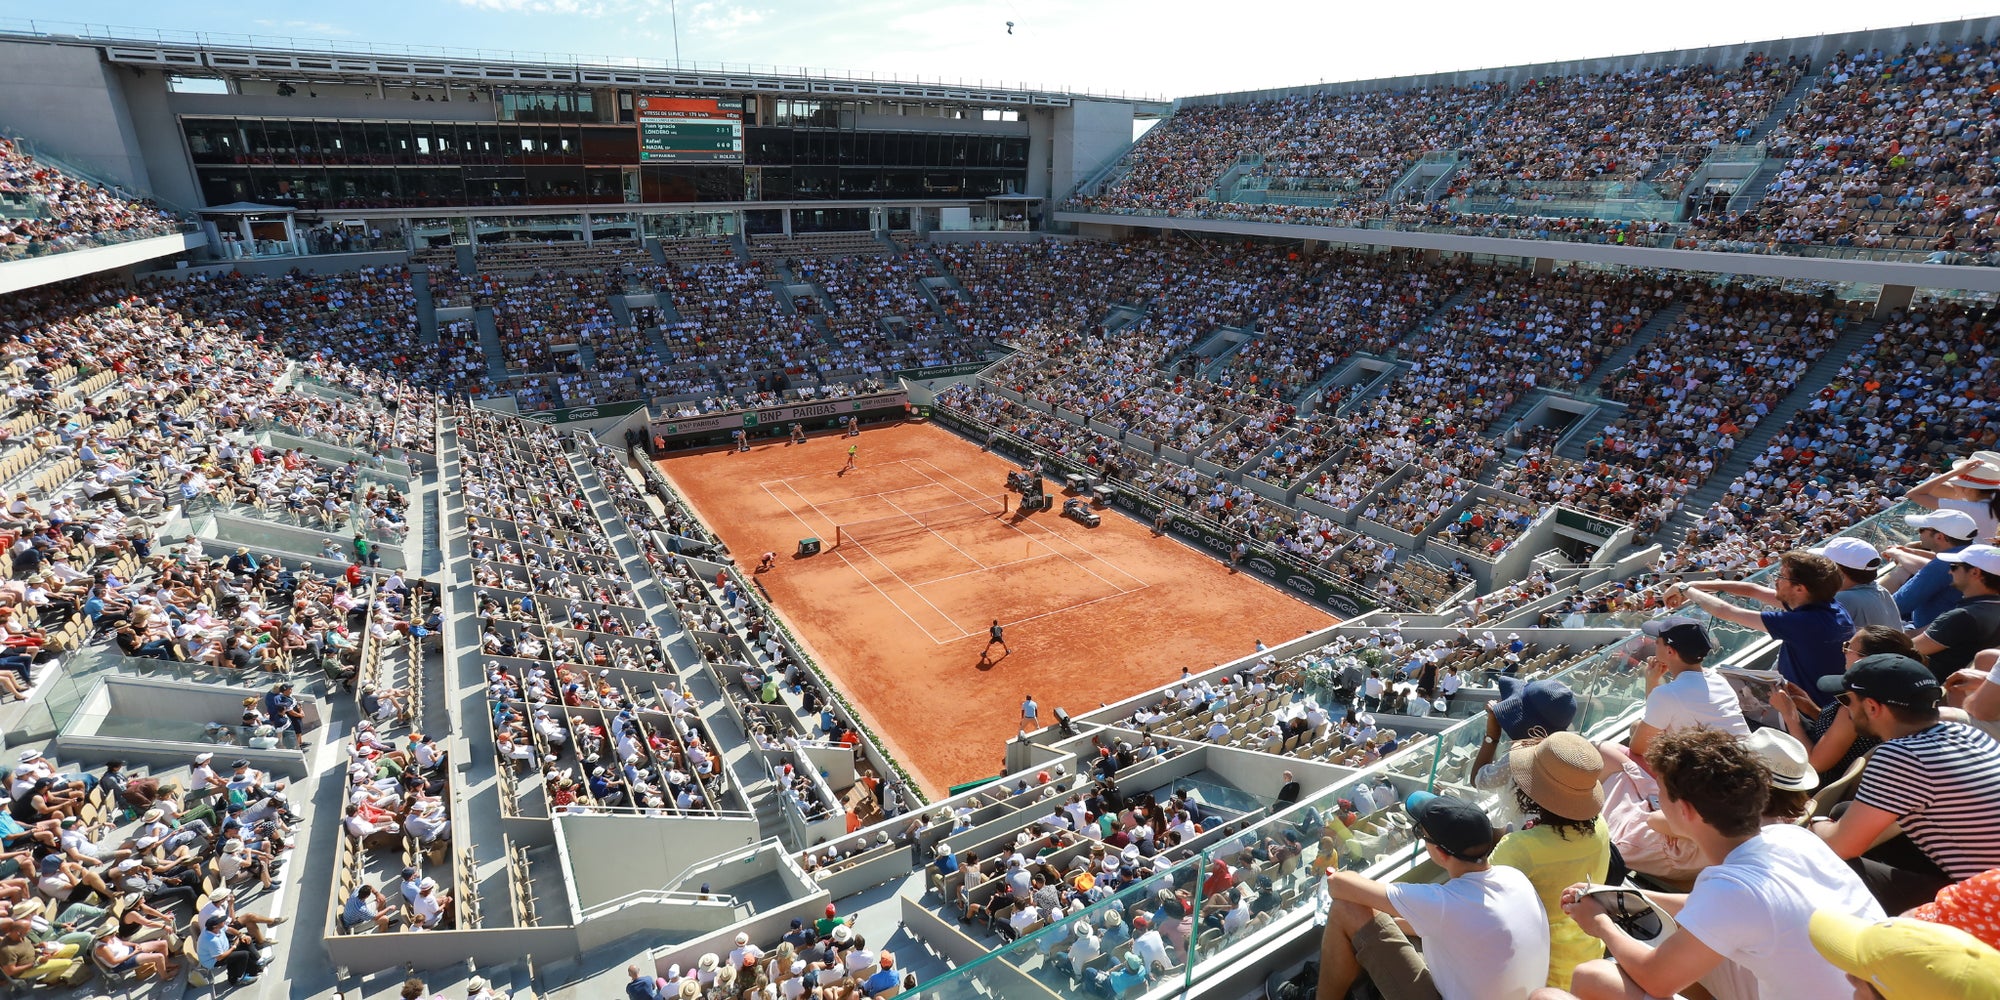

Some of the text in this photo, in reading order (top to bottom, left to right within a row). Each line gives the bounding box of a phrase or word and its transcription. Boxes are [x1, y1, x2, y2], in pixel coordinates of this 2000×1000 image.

[760, 404, 836, 422] BNP PARIBAS
[678, 422, 692, 430] BNP
[692, 419, 719, 428] PARIBAS
[1173, 521, 1199, 537] oppo
[1205, 535, 1232, 552] oppo
